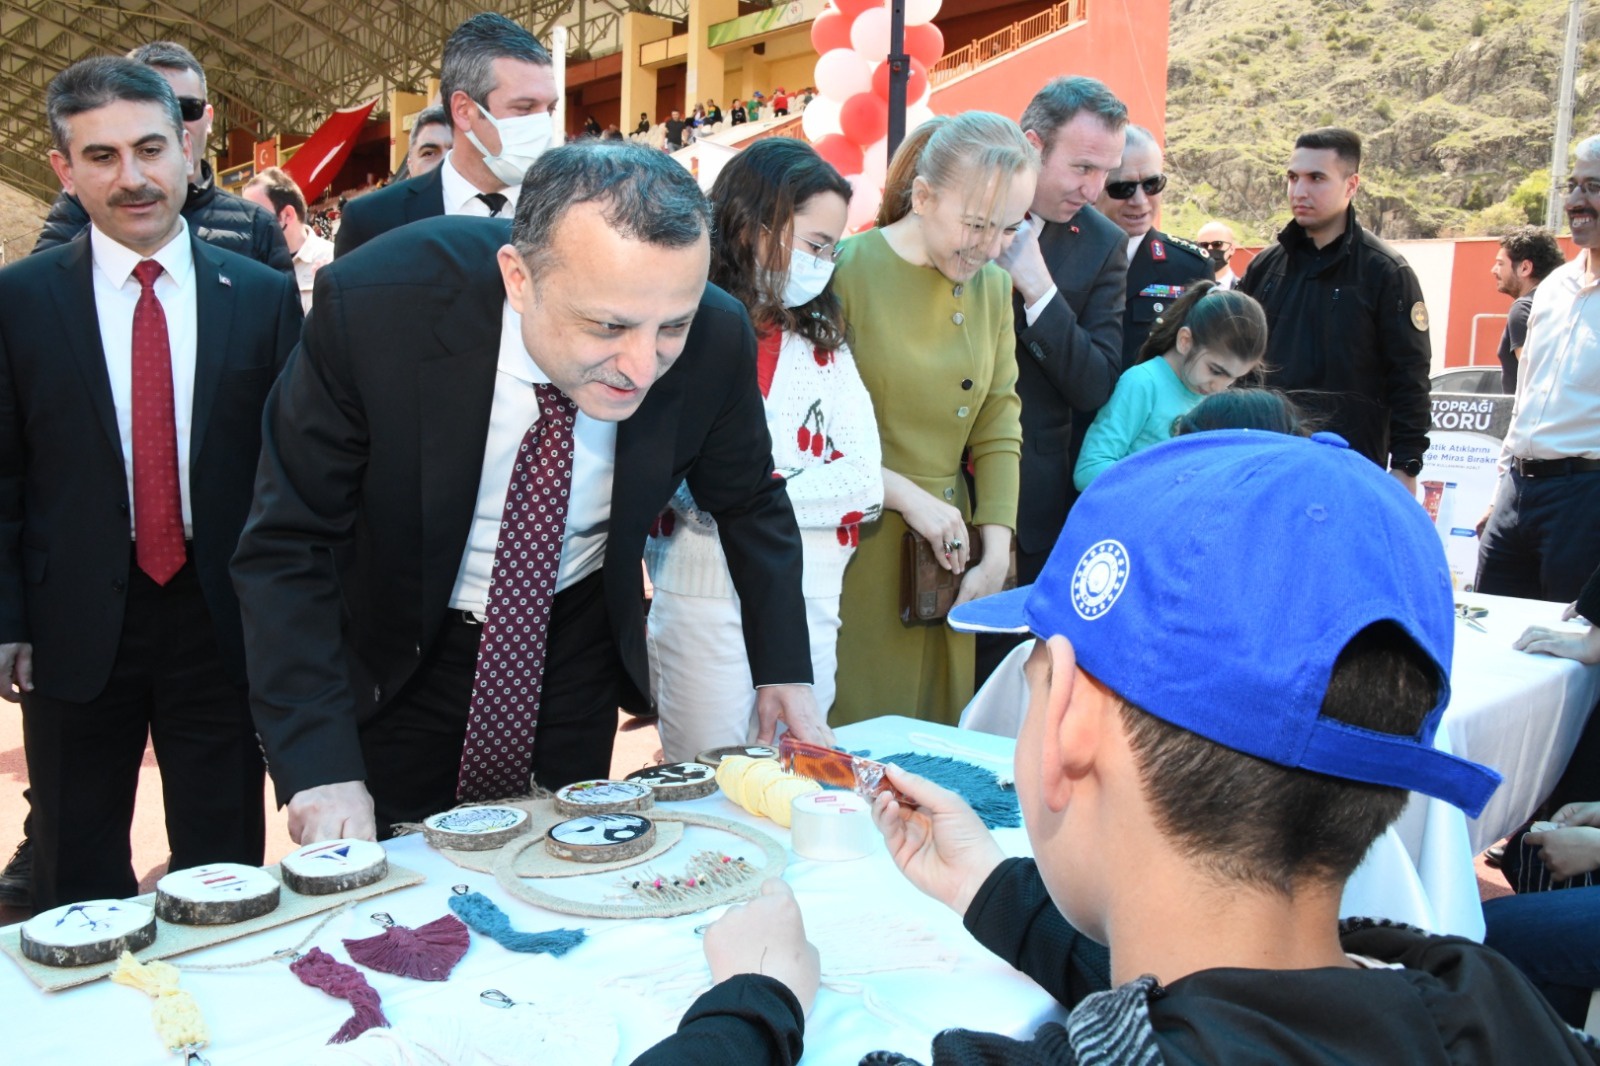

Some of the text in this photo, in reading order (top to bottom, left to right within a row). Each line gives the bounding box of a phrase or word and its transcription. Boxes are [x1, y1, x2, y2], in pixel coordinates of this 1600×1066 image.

[1432, 399, 1493, 413] TOPRAĞI
[1431, 412, 1491, 430] KORU
[1441, 454, 1464, 462] Miras
